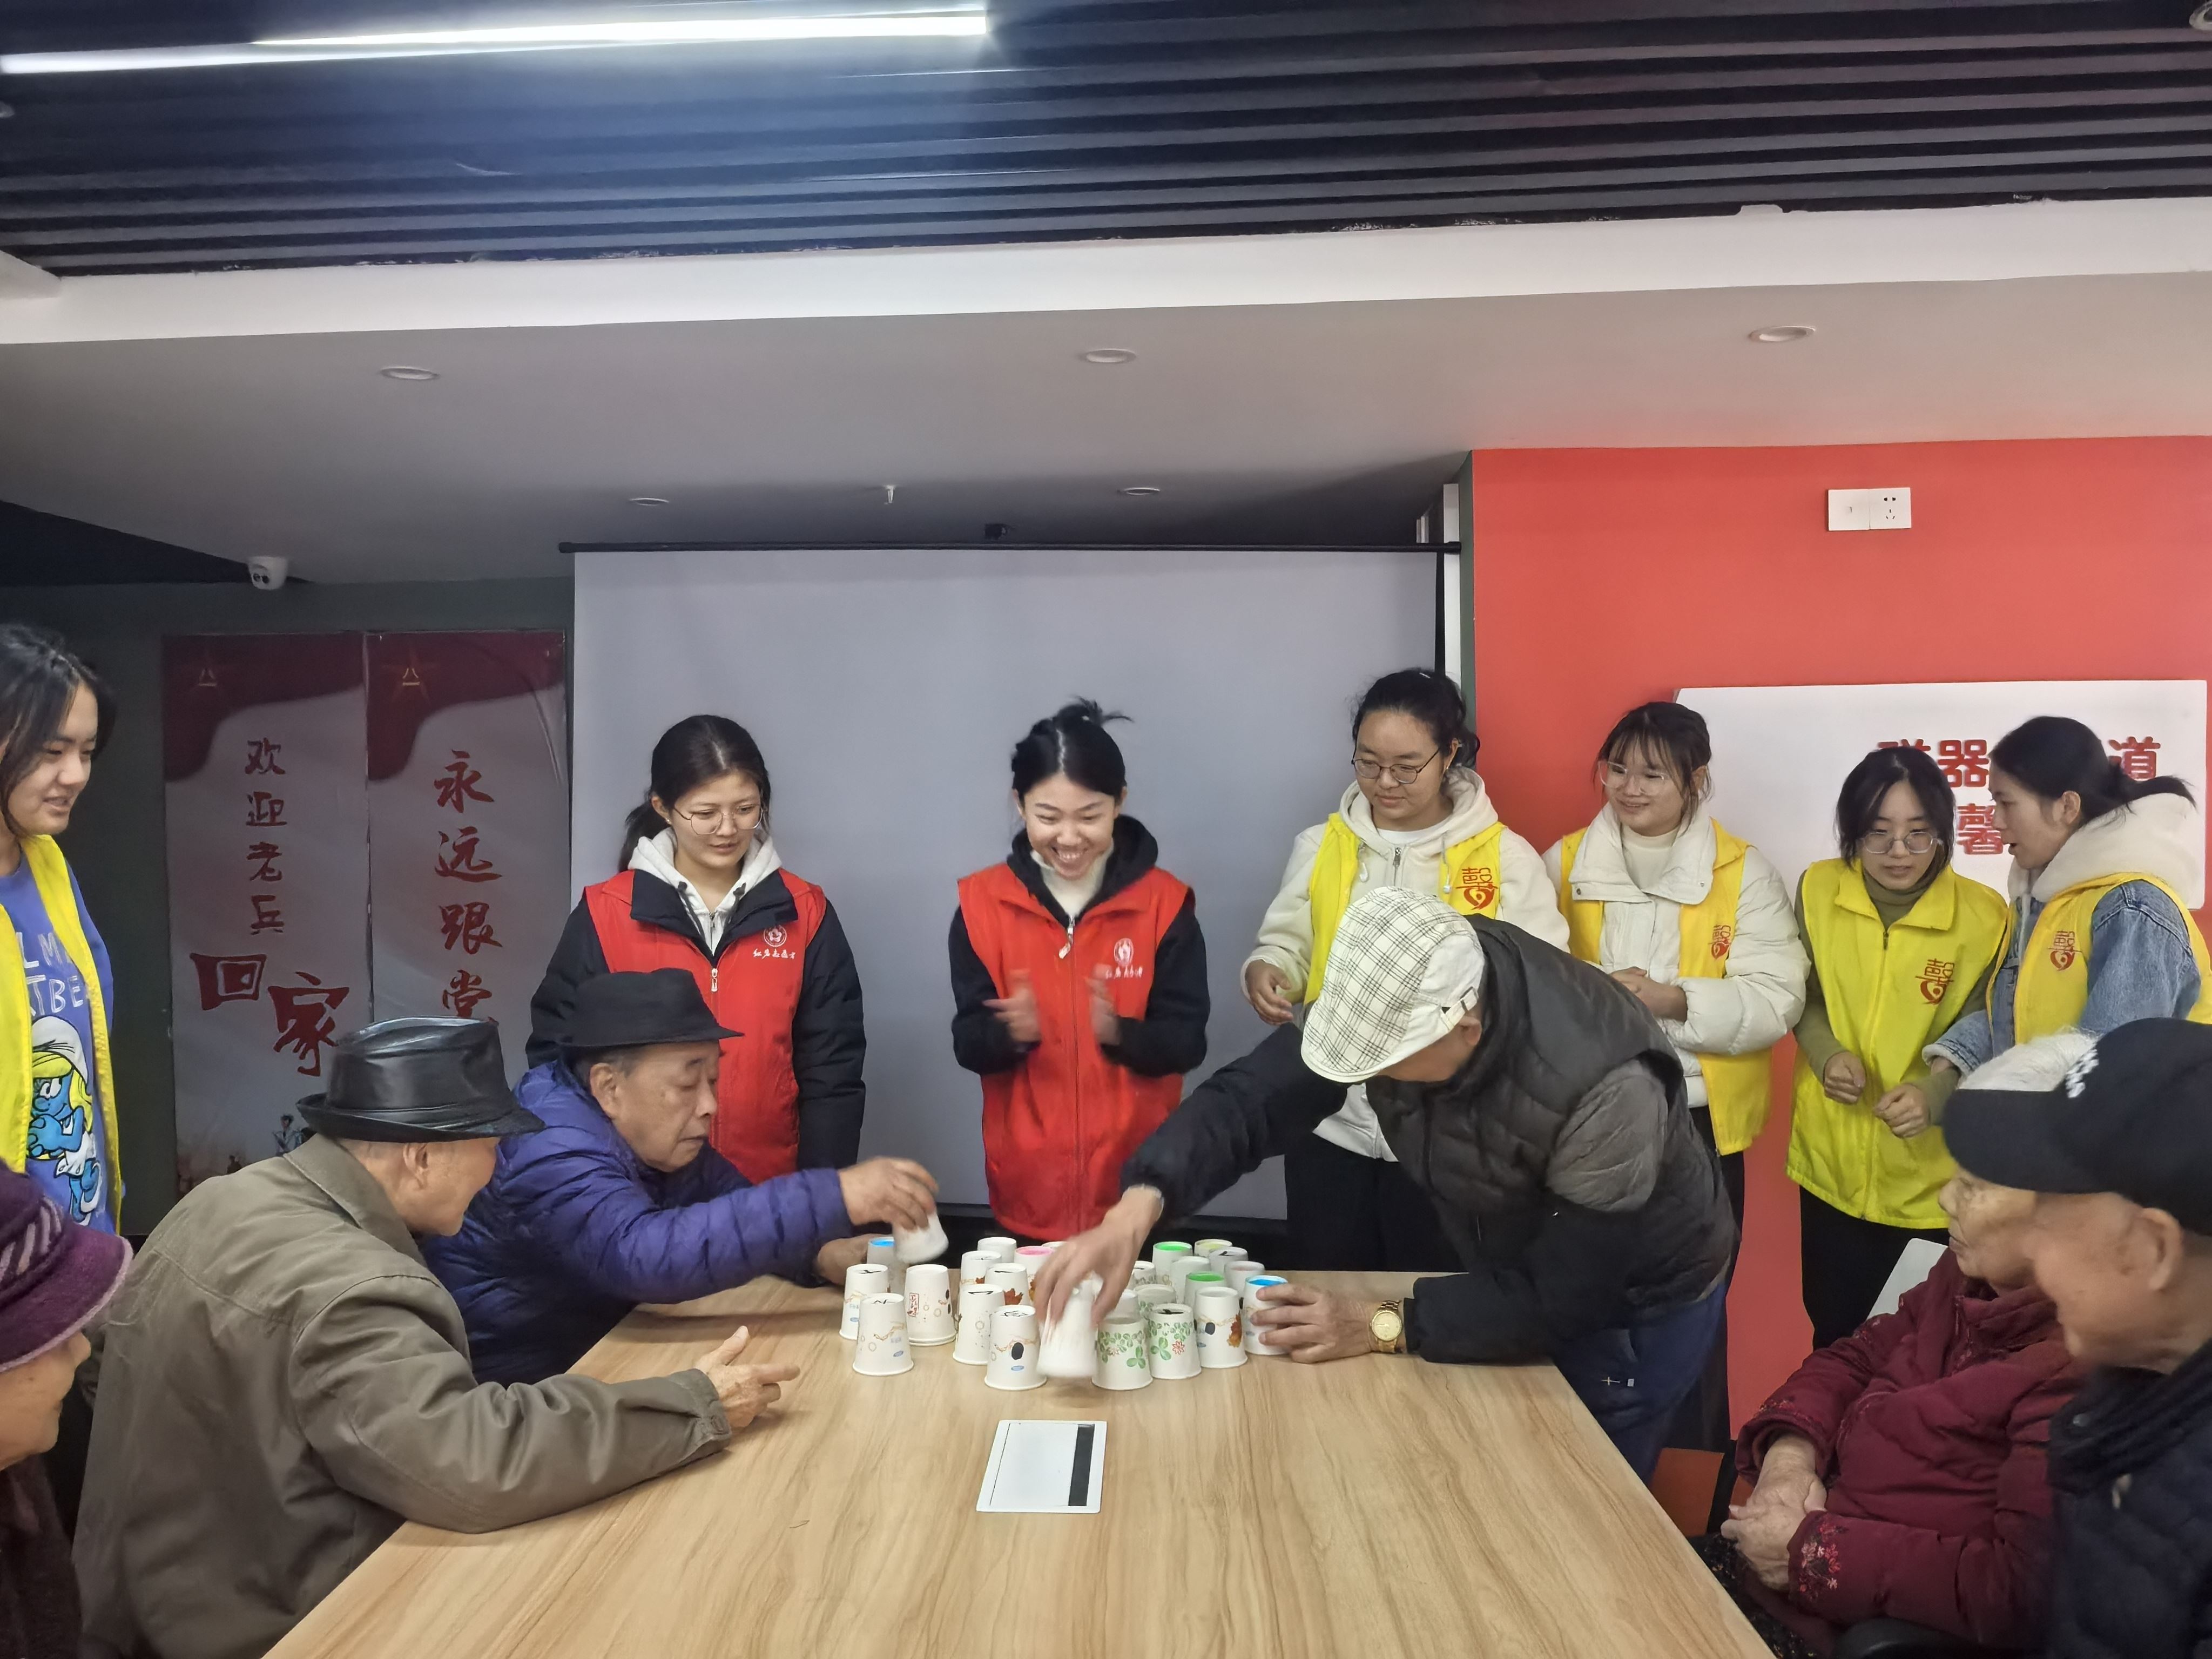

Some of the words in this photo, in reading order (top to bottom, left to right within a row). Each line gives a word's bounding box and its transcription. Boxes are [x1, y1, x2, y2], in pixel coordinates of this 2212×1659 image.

[245, 737, 287, 936] 欢迎老兵
[26, 974, 83, 1016] TBE
